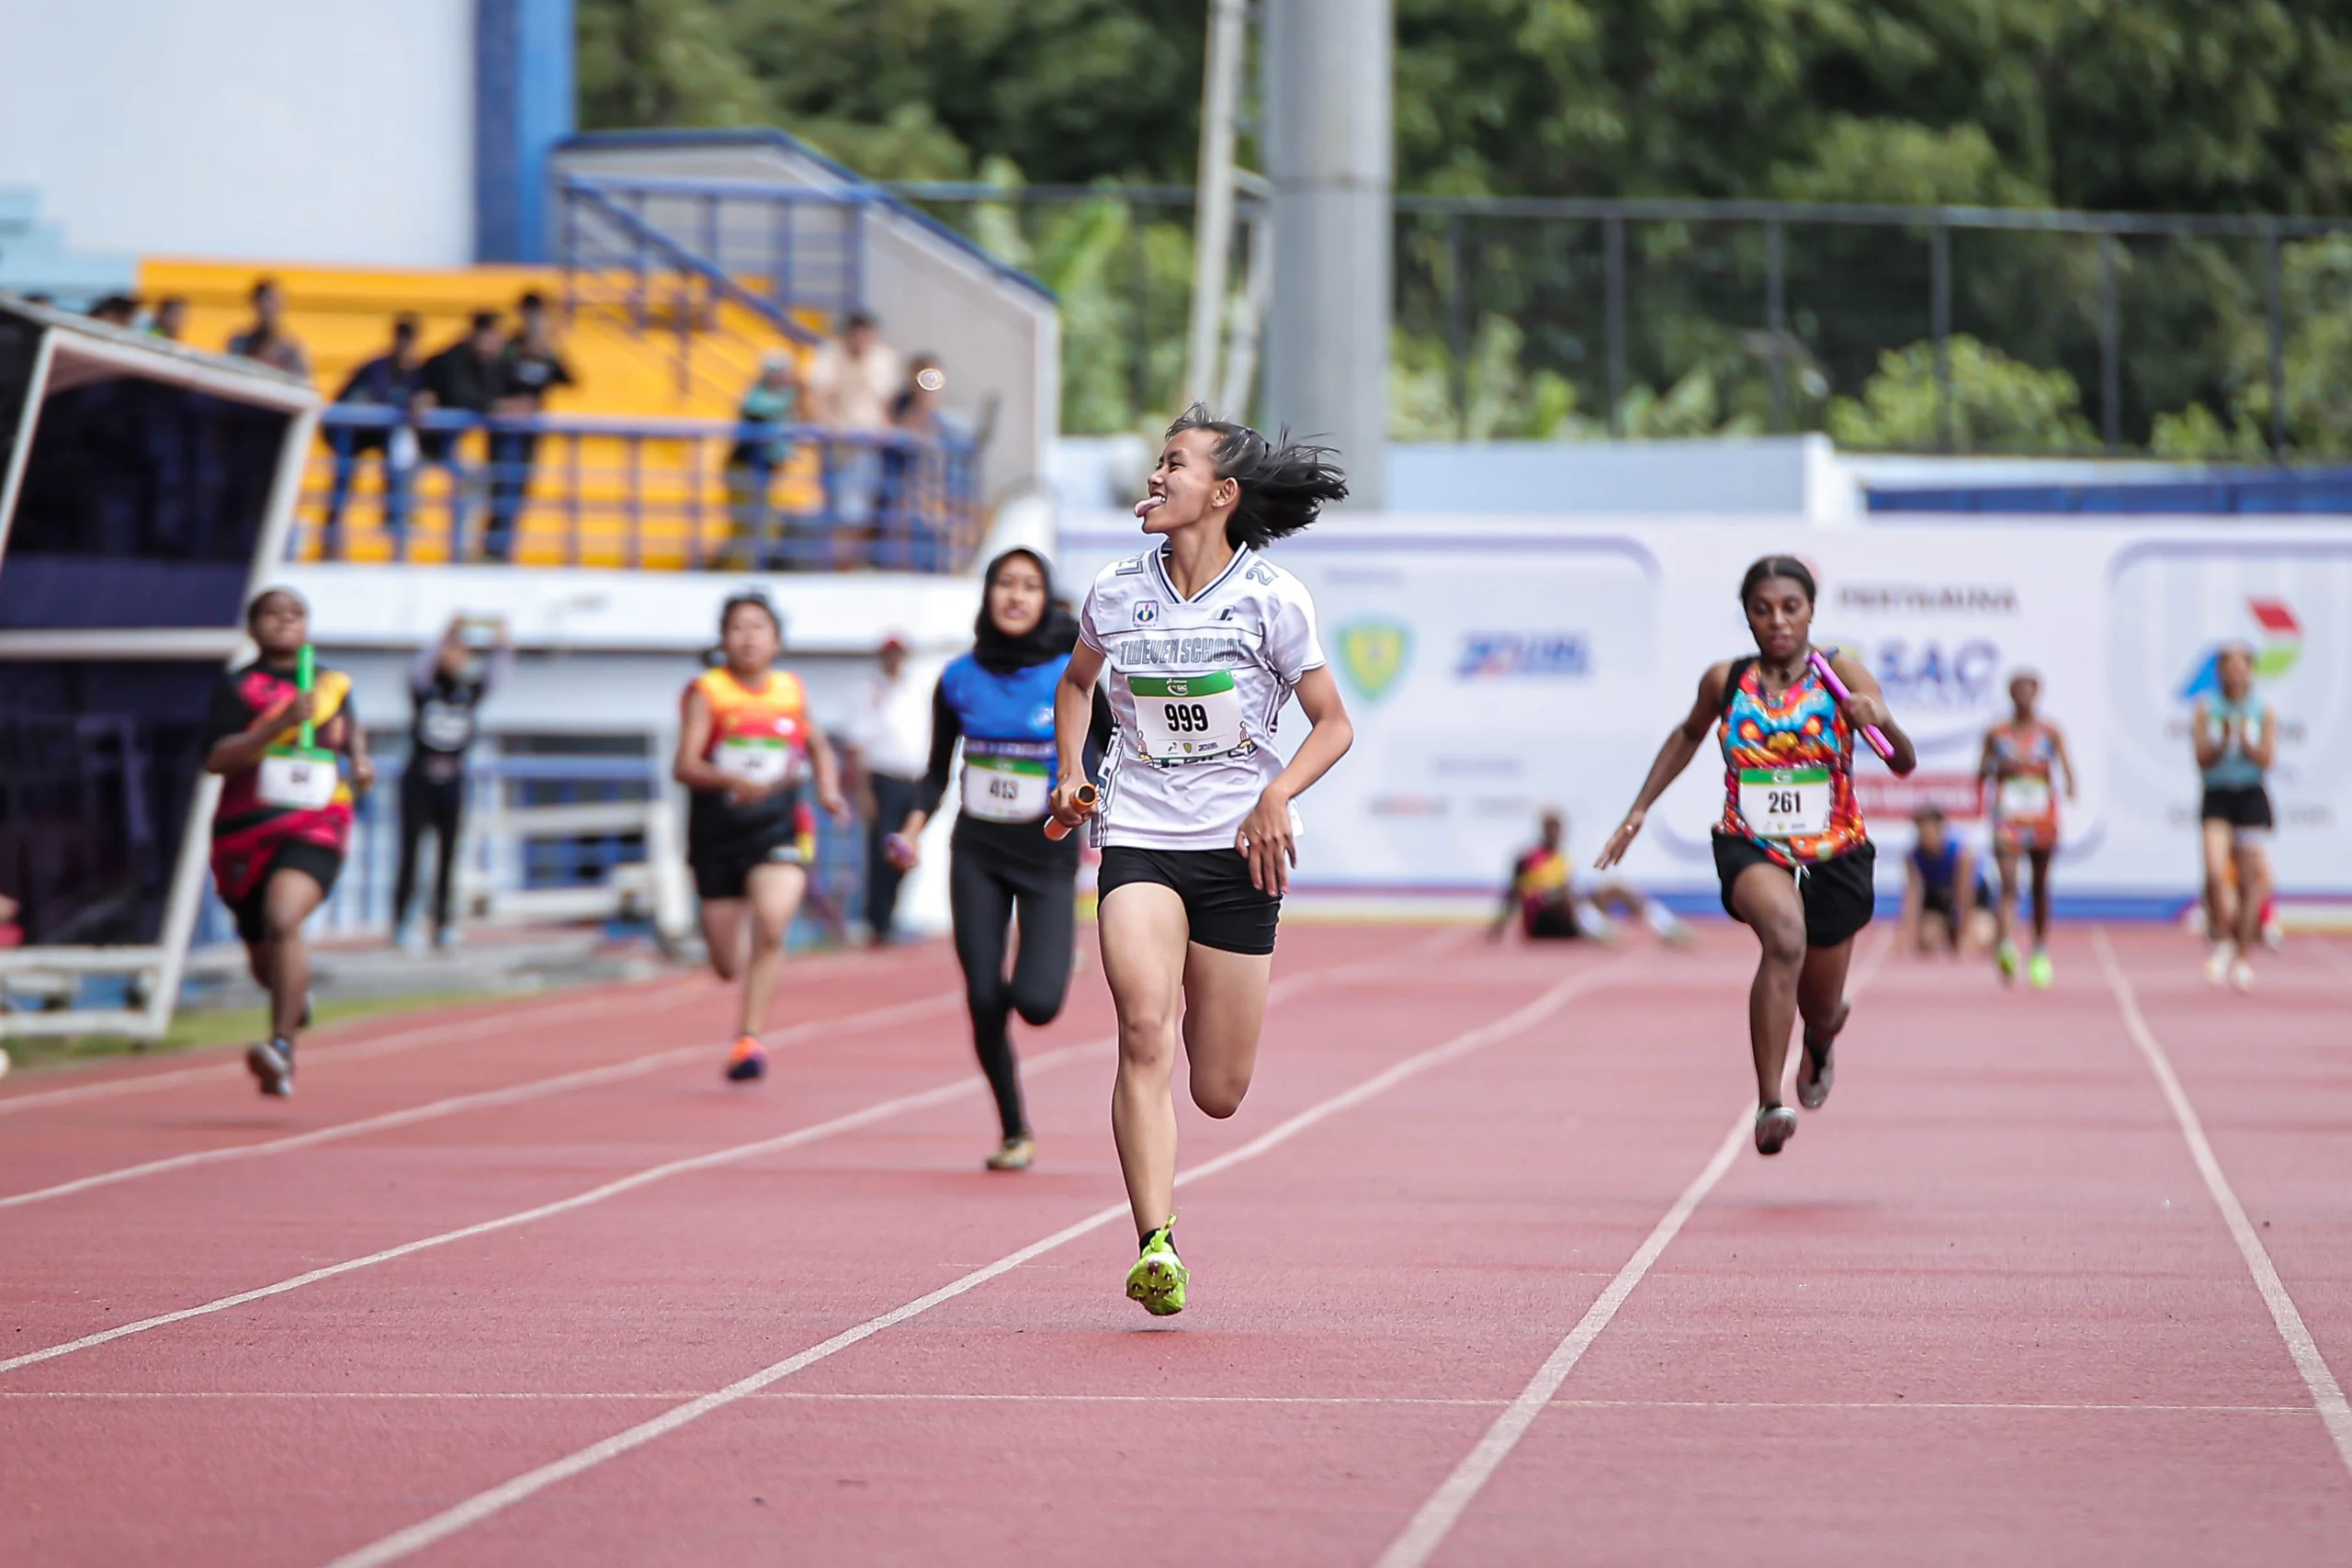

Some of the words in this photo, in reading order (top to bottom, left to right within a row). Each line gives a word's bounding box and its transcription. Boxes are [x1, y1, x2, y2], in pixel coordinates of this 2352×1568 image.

[1181, 637, 1246, 664] SCHOOL
[1164, 703, 1209, 732] 999
[1768, 791, 1801, 813] 261
